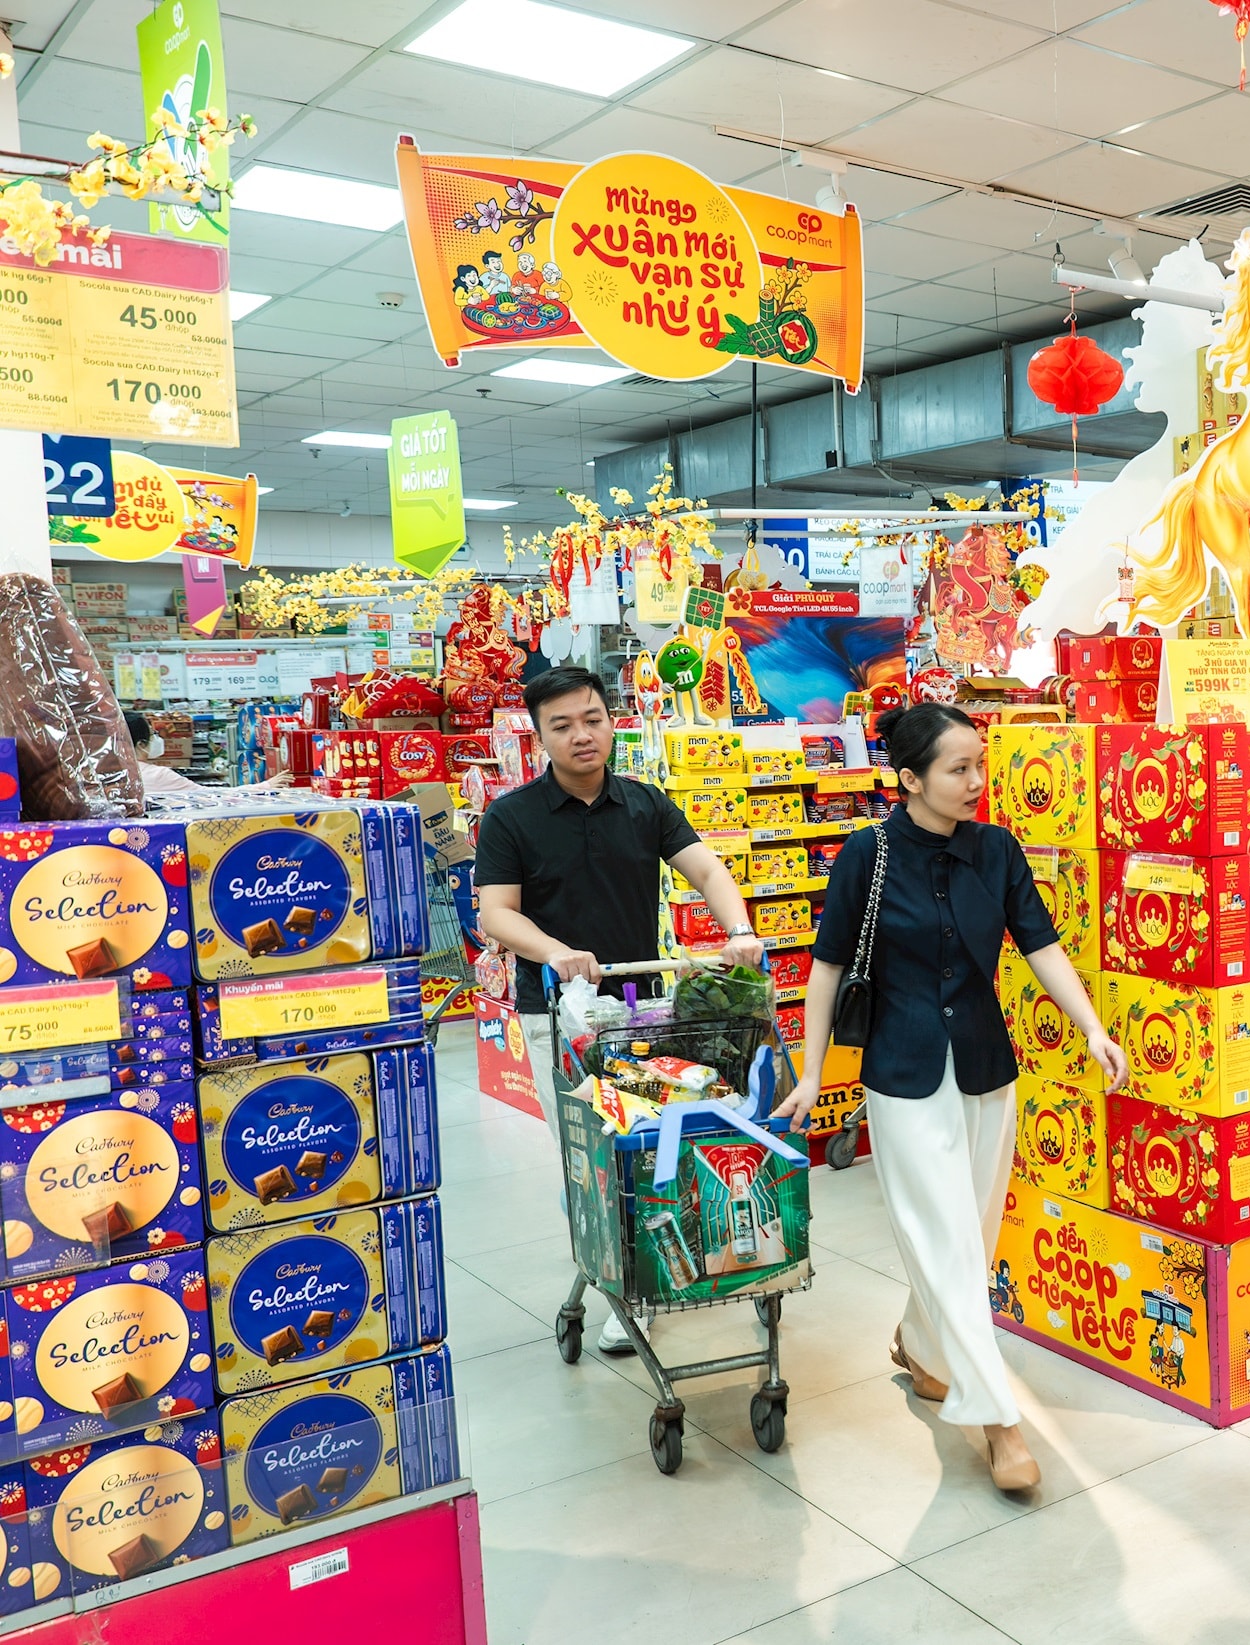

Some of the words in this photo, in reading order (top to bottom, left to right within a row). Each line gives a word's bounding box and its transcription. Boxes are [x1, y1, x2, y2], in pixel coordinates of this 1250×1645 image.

[56, 243, 122, 269] mãi
[79, 280, 111, 292] Socola
[623, 292, 690, 336] như
[697, 294, 726, 348] ý
[83, 357, 115, 368] Socola
[400, 426, 422, 457] GIÁ
[423, 419, 447, 452] TỐT
[44, 459, 106, 505] 22
[136, 476, 162, 492] đủ
[401, 462, 422, 492] MỖI
[423, 463, 450, 489] NGÀY
[133, 497, 166, 511] đầy
[147, 511, 174, 524] vui
[772, 594, 793, 602] Giải
[768, 605, 792, 613] Google
[1204, 658, 1211, 667] 3
[1195, 679, 1230, 692] 599K
[400, 751, 425, 761] COSY
[1030, 790, 1046, 805] LỘC
[62, 871, 123, 887] Cadbury
[24, 889, 158, 923] Selection
[250, 898, 284, 906] ASSORTED
[288, 895, 317, 903] FLAVORS
[225, 983, 263, 995] Khuyến
[265, 981, 284, 991] mãi
[1041, 1025, 1057, 1041] LỘC
[75, 1137, 135, 1155] Cadbury
[39, 1153, 170, 1192] Selection
[85, 1309, 144, 1330] Cadbury
[49, 1324, 179, 1369] Selection
[290, 1420, 336, 1439] Cadbury
[263, 1433, 363, 1473] Selection
